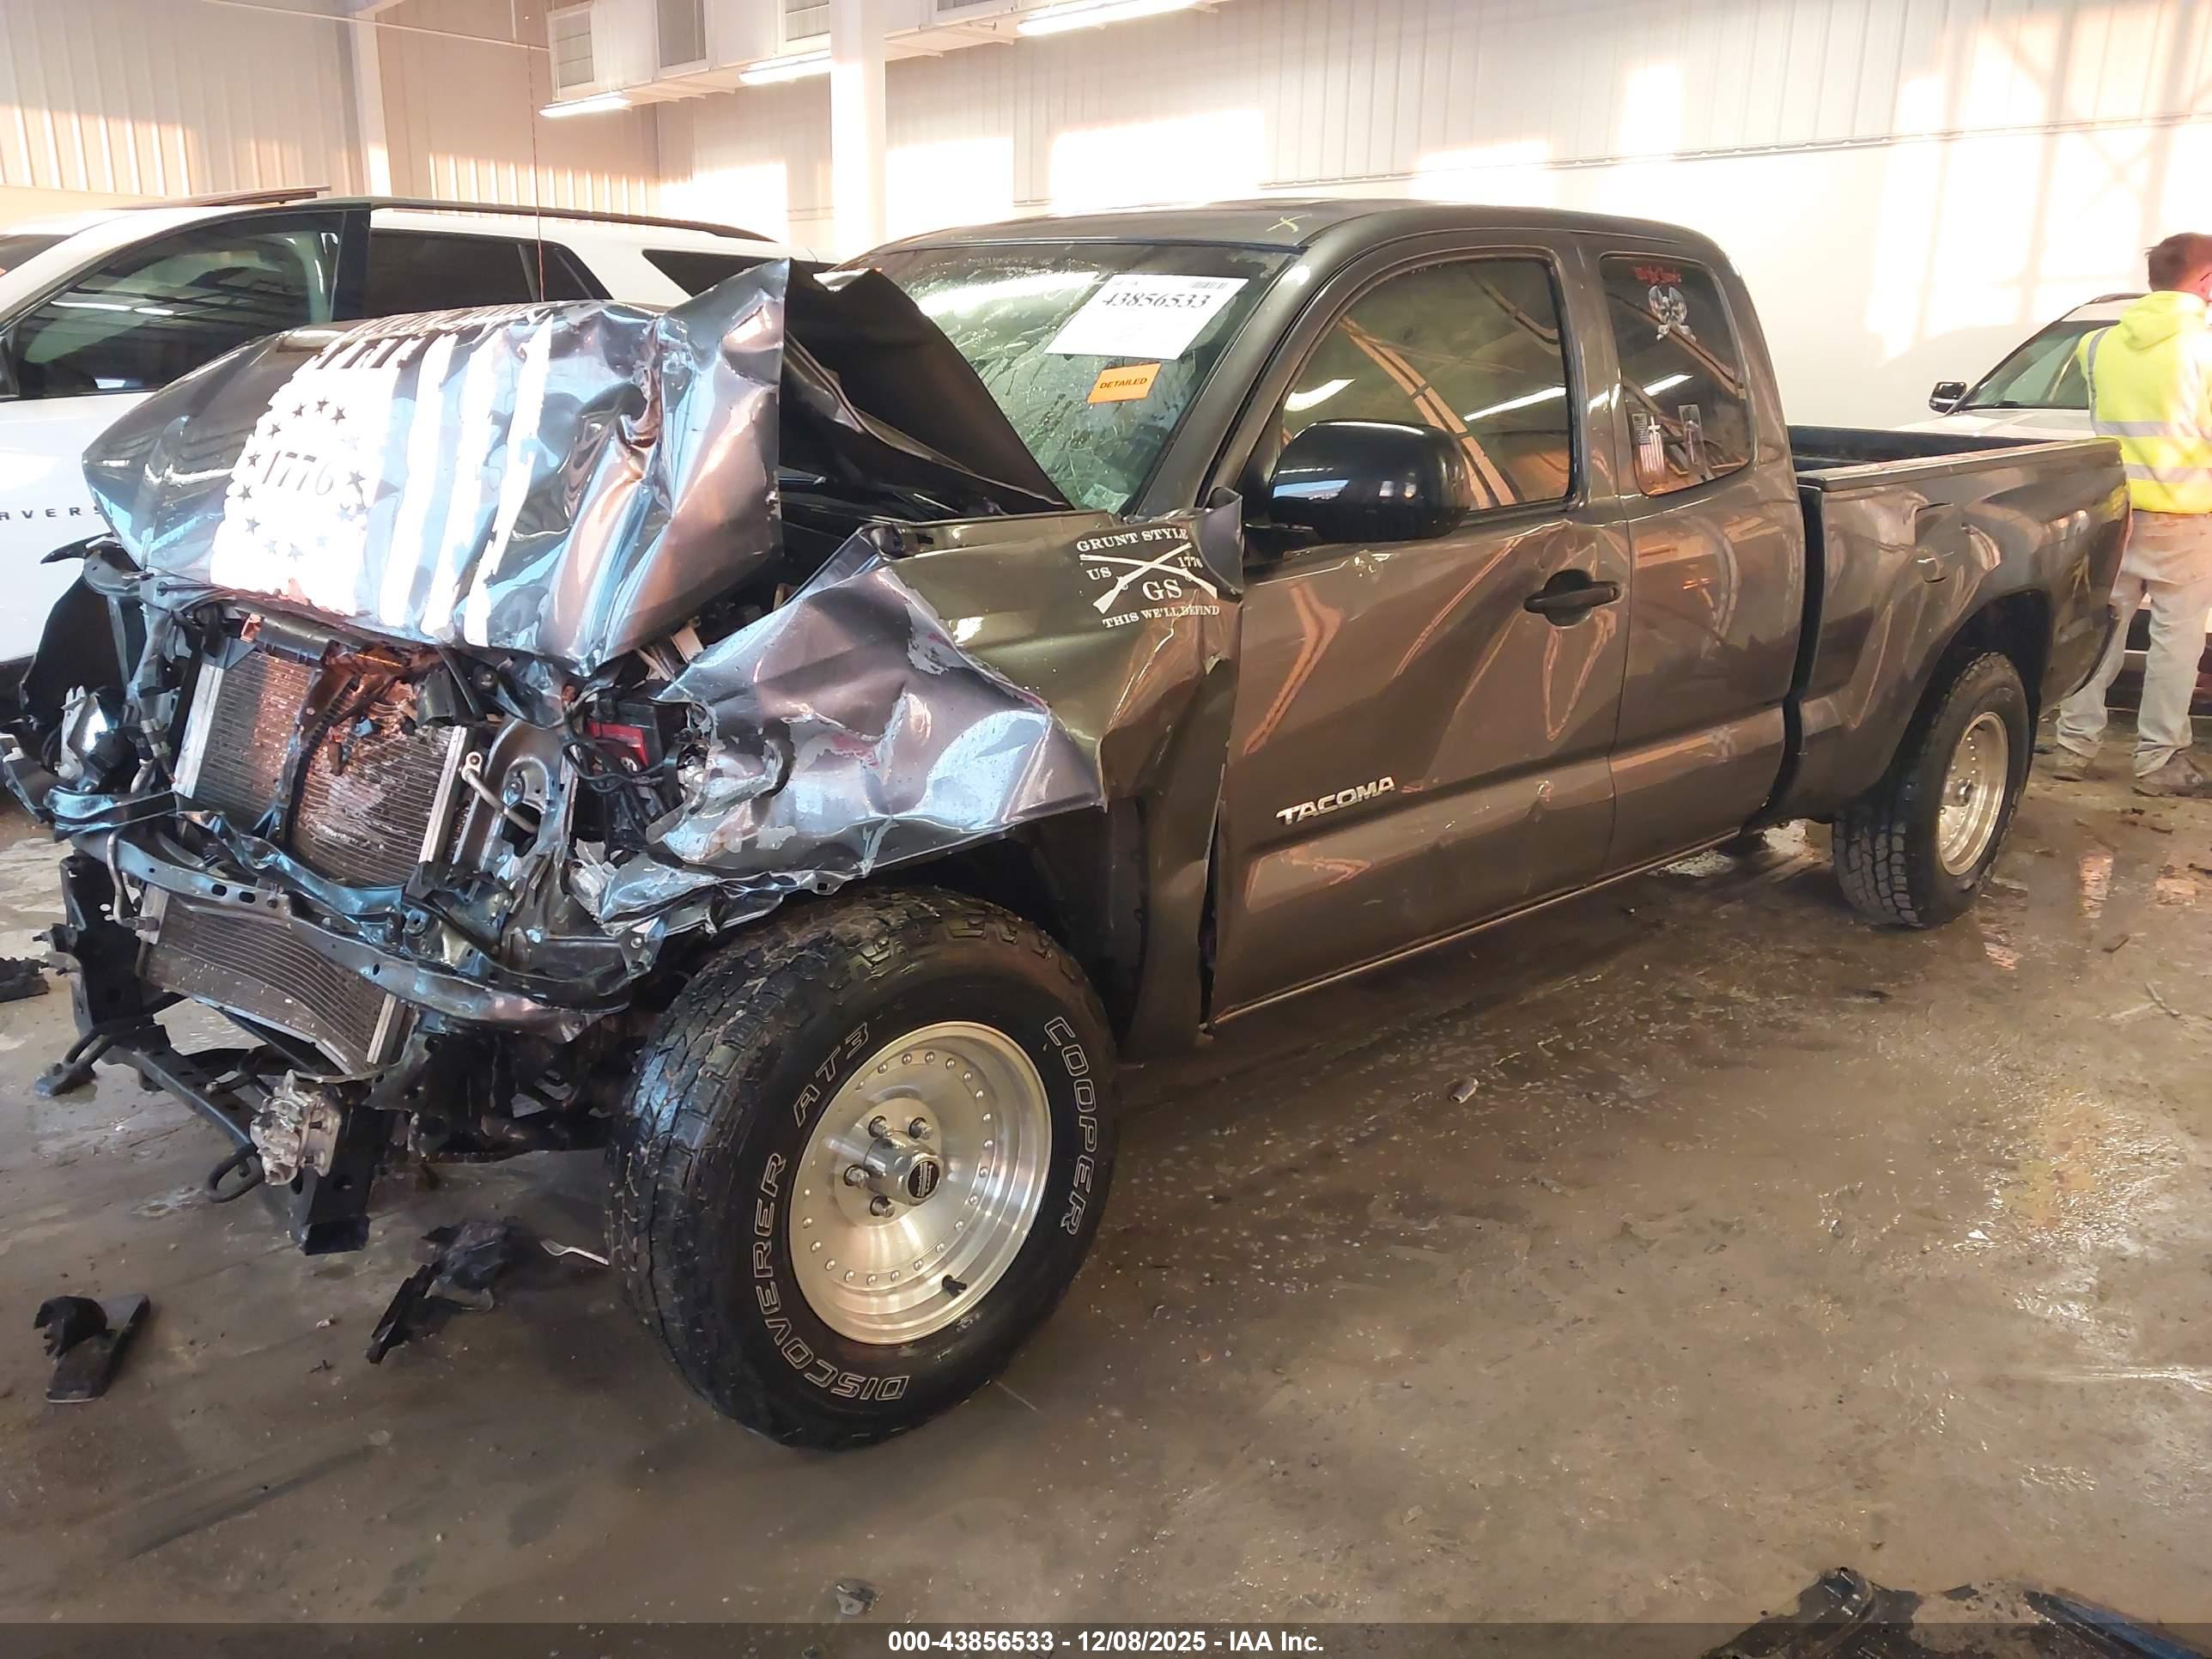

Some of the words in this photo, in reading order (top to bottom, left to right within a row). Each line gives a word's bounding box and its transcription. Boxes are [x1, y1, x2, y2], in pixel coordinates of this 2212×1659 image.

[1103, 292, 1212, 308] 43856533
[1099, 376, 1148, 389] DETAILED
[261, 449, 335, 495] 1776
[1076, 532, 1139, 552] GRUNT
[1141, 527, 1188, 542] STYLE
[1085, 566, 1112, 580] US
[1142, 578, 1182, 601] GS
[1102, 611, 1139, 629] THIS
[1140, 608, 1180, 620] WE'LL
[1275, 776, 1395, 824] TACOMA
[792, 1023, 870, 1127] AT3
[1043, 1016, 1100, 1236] COOPER
[752, 1152, 910, 1401] DISCOVERER
